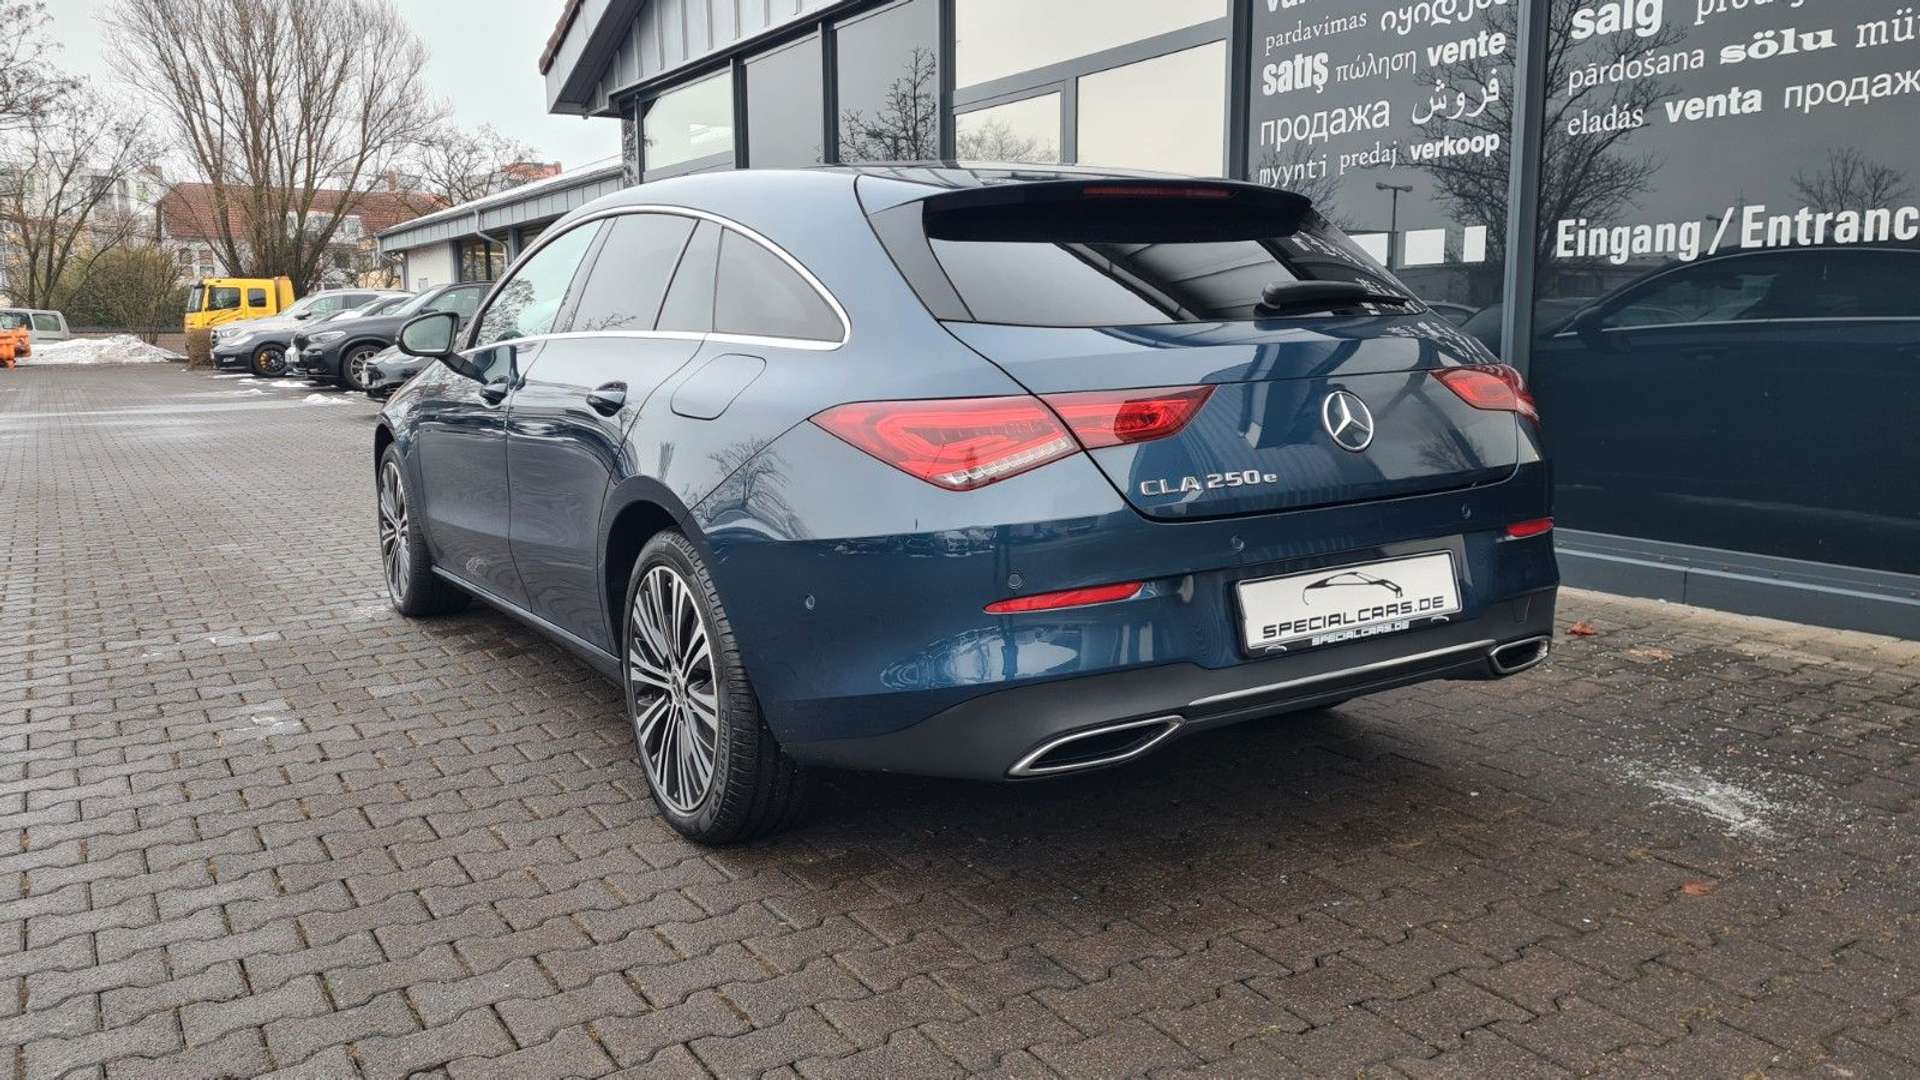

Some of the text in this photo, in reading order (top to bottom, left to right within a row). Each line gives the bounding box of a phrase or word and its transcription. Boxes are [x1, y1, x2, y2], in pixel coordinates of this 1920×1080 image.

[1265, 12, 1368, 55] pardavimas
[1571, 0, 1663, 39] salg
[1335, 50, 1417, 83] πώληση
[1427, 30, 1506, 67] vente
[1568, 7, 1920, 96] pārdošana sölu mü
[1262, 51, 1329, 96] satış
[1411, 68, 1500, 125] فروش
[1567, 87, 1763, 137] eladás venta
[1261, 100, 1390, 152] продажа
[1259, 133, 1500, 188] myynti predaj verkoop
[1556, 218, 1700, 264] Eingang
[1140, 476, 1202, 496] CLA
[1263, 596, 1444, 639] SPECIALCARS.DE
